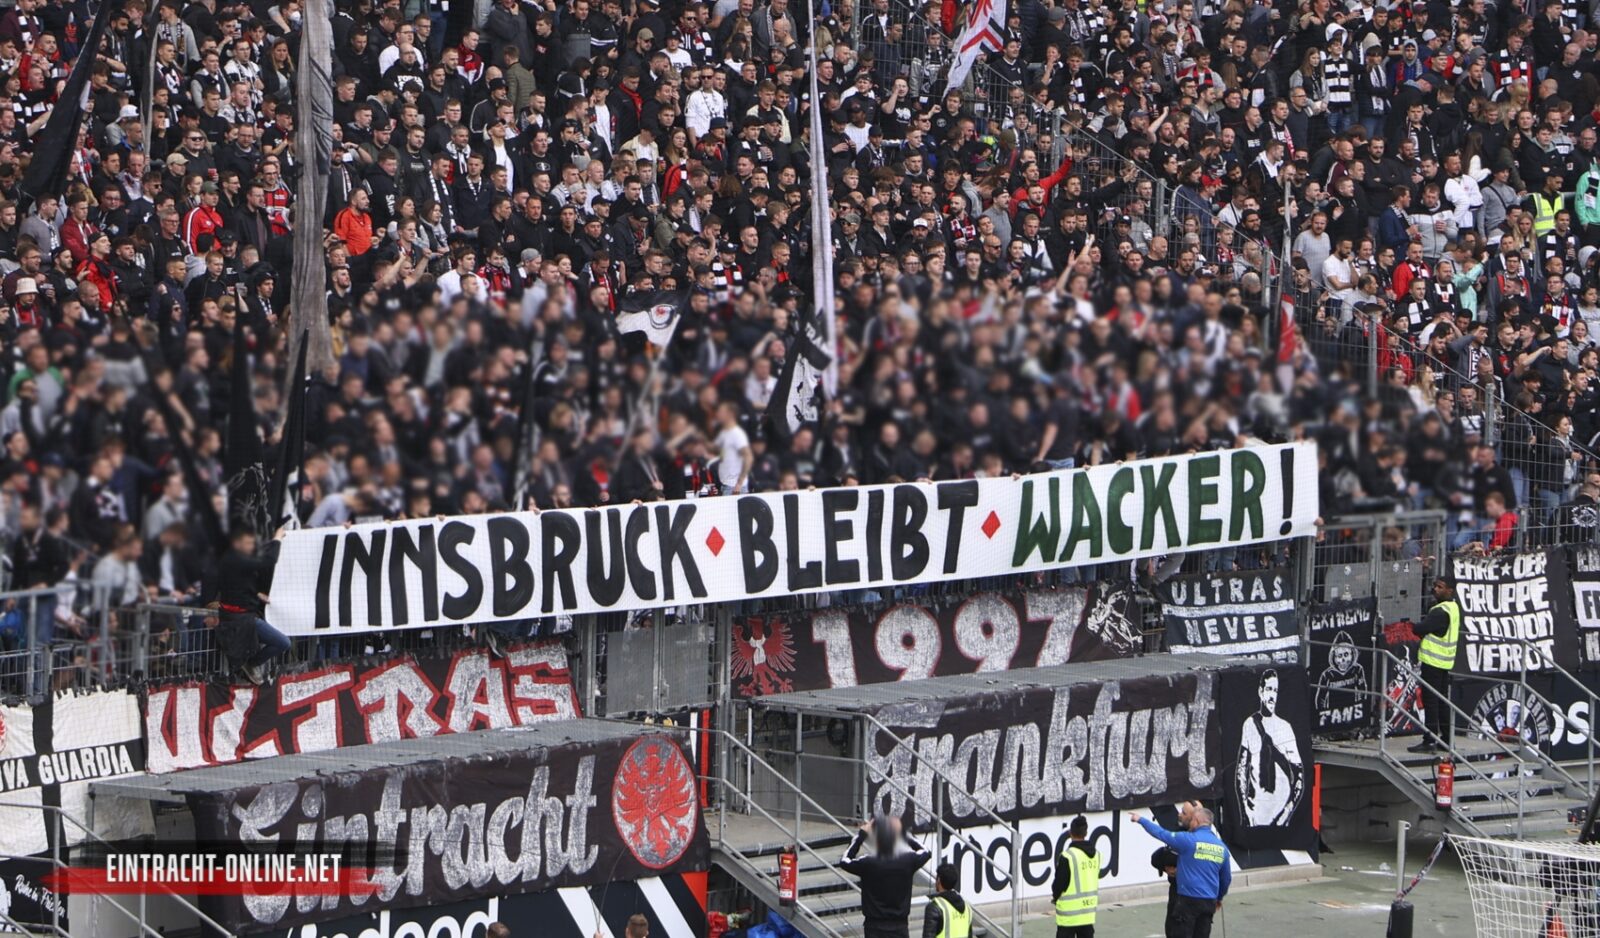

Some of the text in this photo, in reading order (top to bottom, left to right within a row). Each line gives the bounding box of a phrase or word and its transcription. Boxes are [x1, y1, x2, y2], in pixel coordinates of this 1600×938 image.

[315, 503, 708, 629] INNSBRUCK
[737, 480, 979, 594] BLEIBT
[1513, 551, 1548, 580] DER
[1171, 575, 1283, 606] ULTRAS
[1456, 577, 1550, 614] GRUPPE
[812, 587, 1089, 690] 1997
[1184, 615, 1280, 645] NEVER
[1464, 610, 1554, 642] STADION
[146, 641, 582, 775] ULTRAS
[1319, 702, 1364, 727] FANS
[0, 744, 135, 792] VA GUARDIA
[867, 680, 1215, 828] Frankfurt
[232, 752, 599, 925] Eintracht
